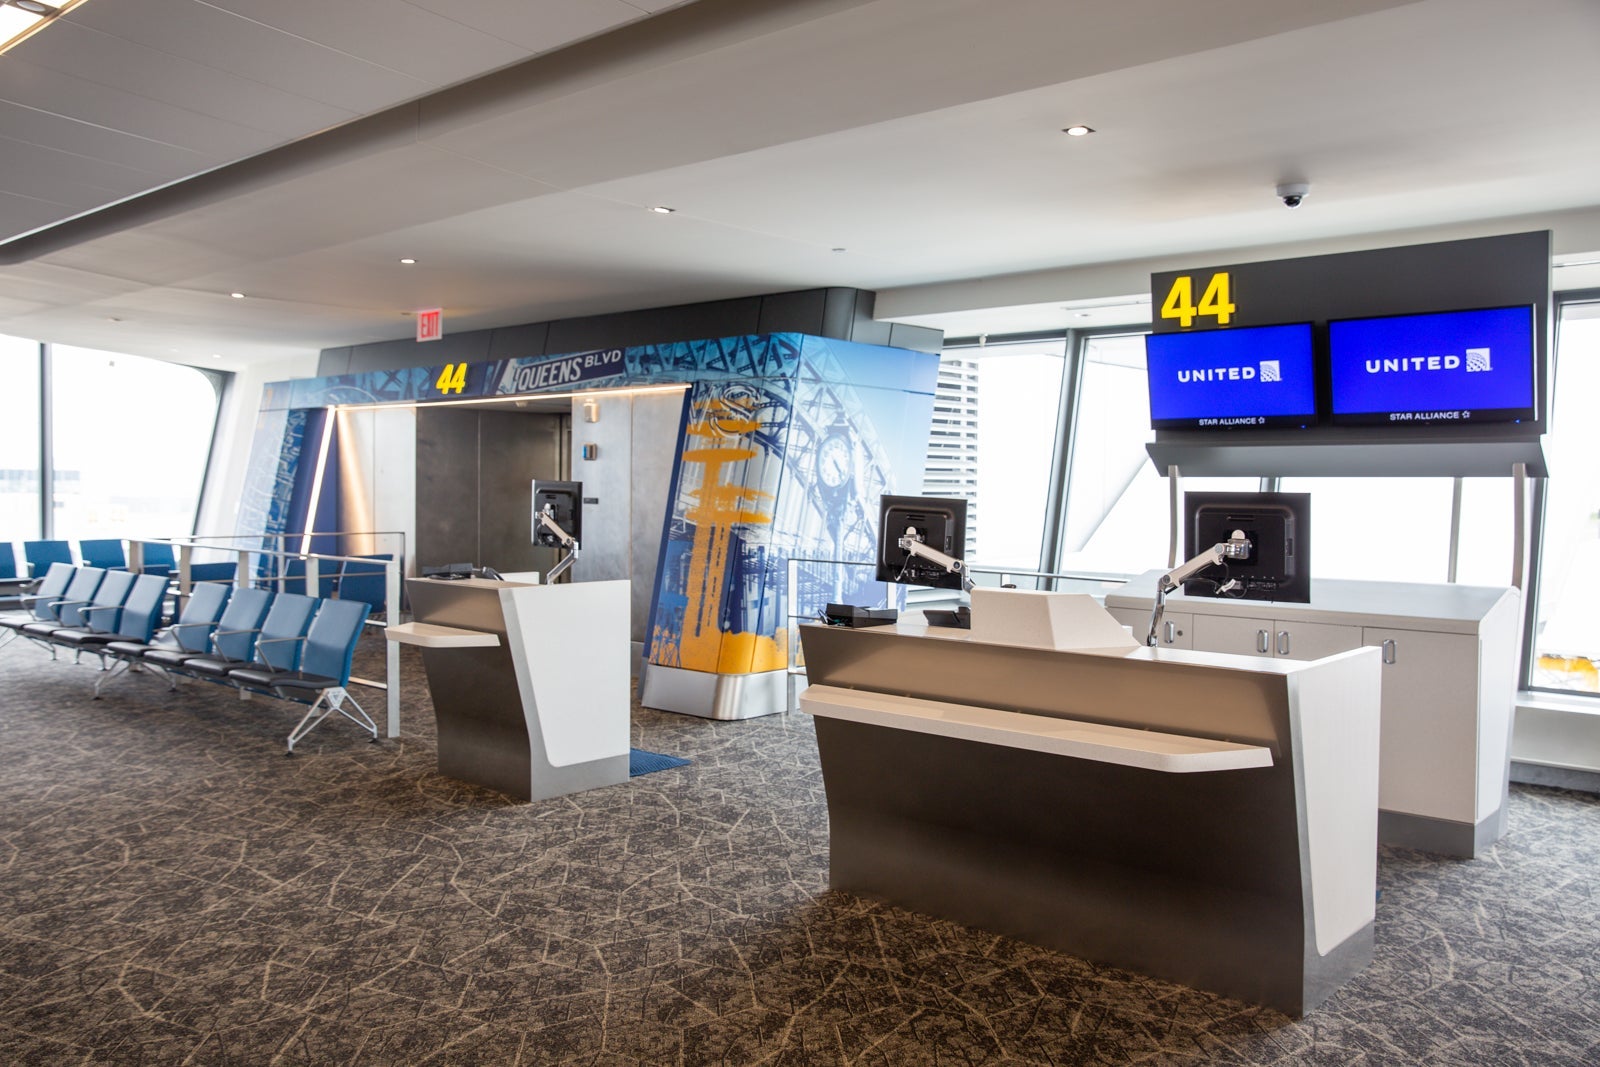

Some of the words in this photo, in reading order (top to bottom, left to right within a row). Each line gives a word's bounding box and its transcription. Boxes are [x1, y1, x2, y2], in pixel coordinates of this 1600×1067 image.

[1161, 272, 1235, 326] 44
[421, 311, 439, 338] EXIT
[518, 357, 582, 391] QUEENS
[585, 350, 621, 368] BLVD
[1178, 367, 1255, 383] UNITED
[1366, 356, 1460, 373] UNITED
[436, 363, 467, 394] 44
[1219, 417, 1256, 425] ALLIANCE
[1390, 413, 1412, 421] STAR
[1414, 411, 1460, 420] ALLIANCE
